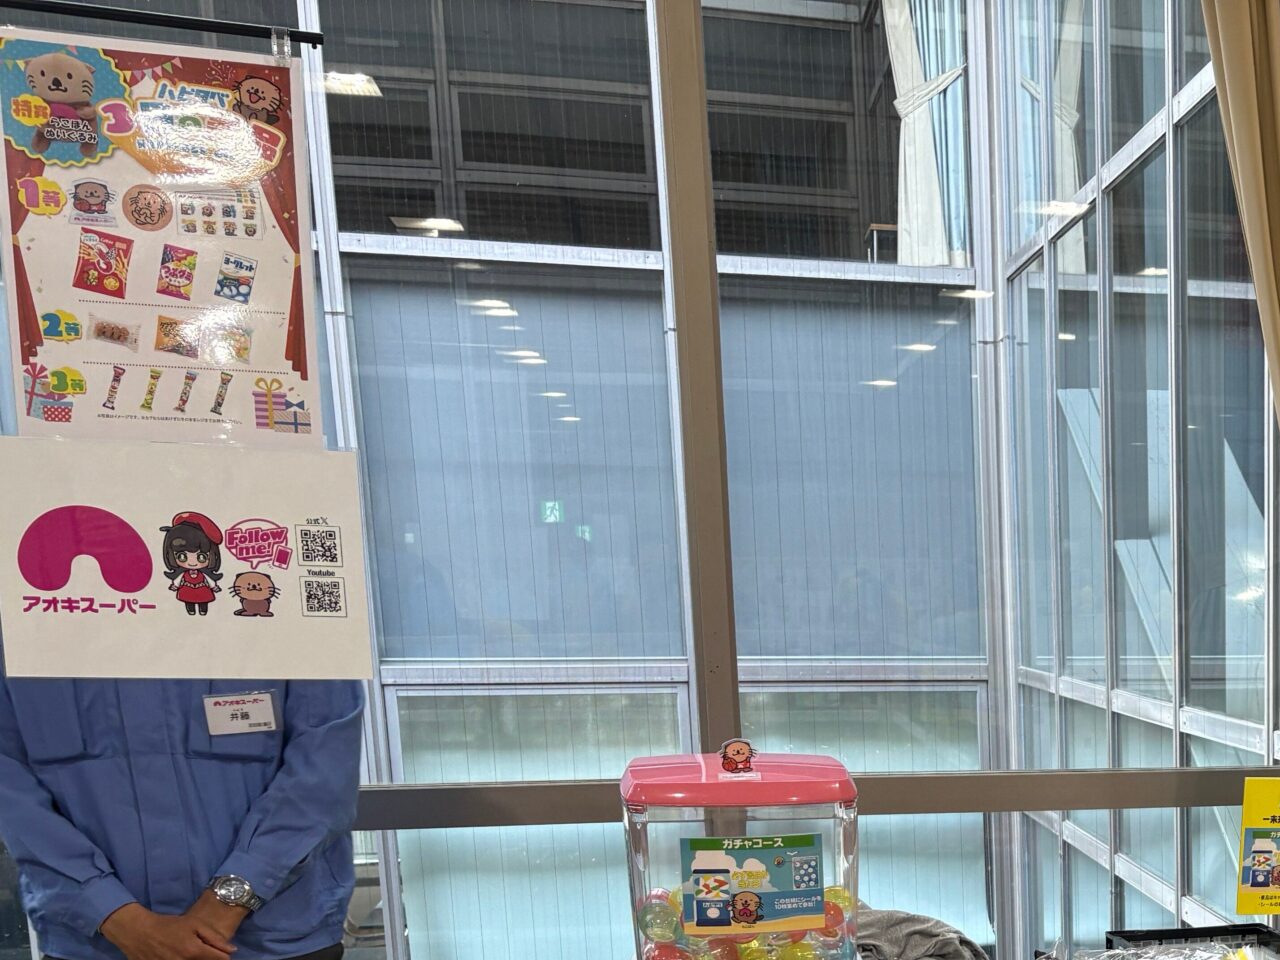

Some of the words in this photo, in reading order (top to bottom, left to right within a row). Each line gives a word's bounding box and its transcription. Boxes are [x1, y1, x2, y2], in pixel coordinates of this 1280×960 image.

[45, 129, 97, 143] ぬいぐるみ
[225, 526, 288, 548] Follow
[236, 542, 273, 558] me!
[306, 569, 336, 577] Youtube
[22, 595, 157, 614] アオキスーパー
[722, 837, 783, 849] ガチャコース
